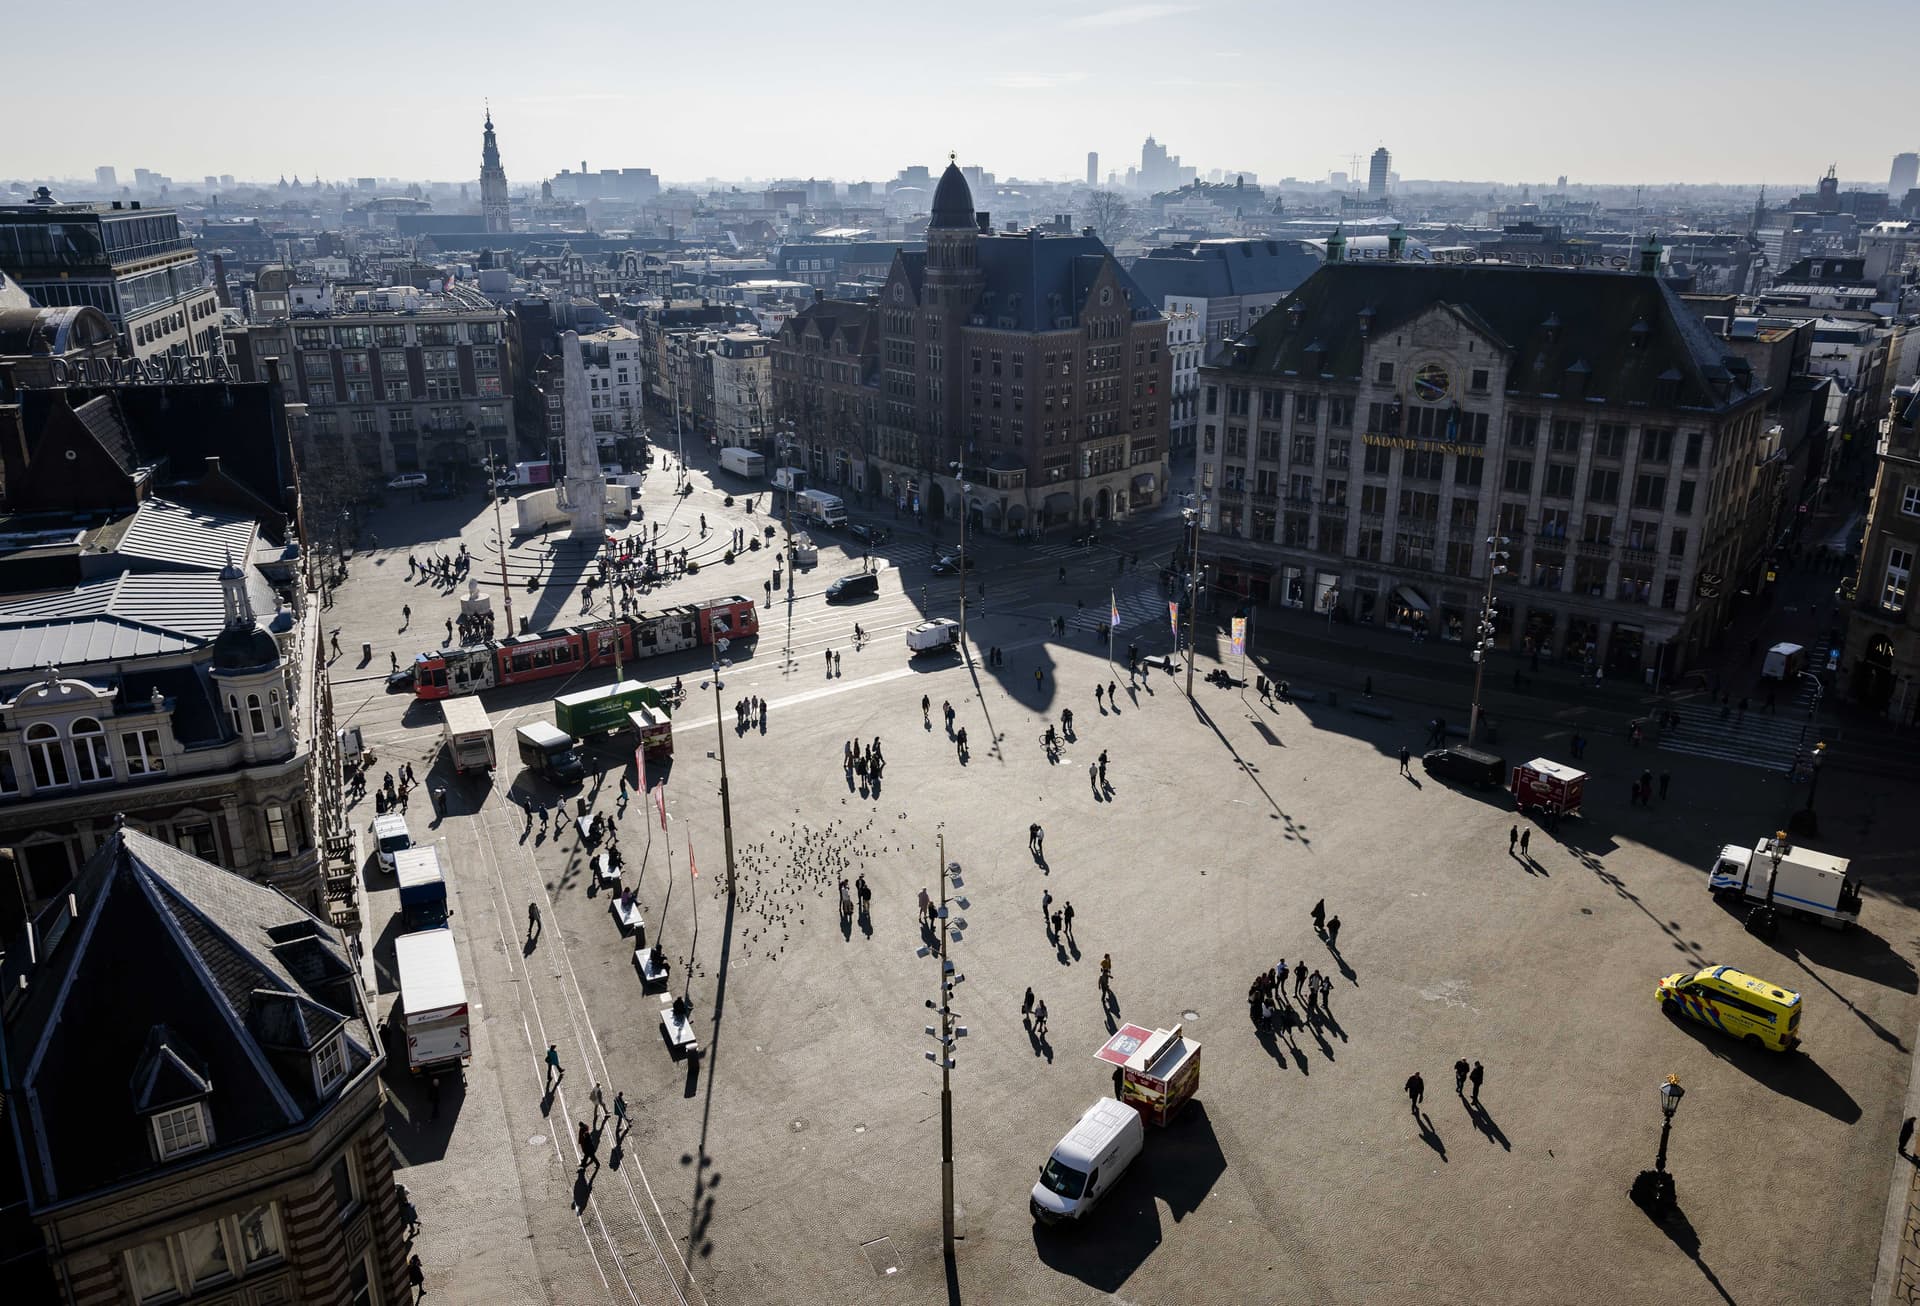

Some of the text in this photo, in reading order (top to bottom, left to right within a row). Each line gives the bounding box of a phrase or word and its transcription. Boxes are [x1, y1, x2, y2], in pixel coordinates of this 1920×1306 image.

[1348, 248, 1402, 261] PEEK
[1431, 248, 1628, 267] CLOPPENBURG
[1361, 433, 1417, 451] MADAME
